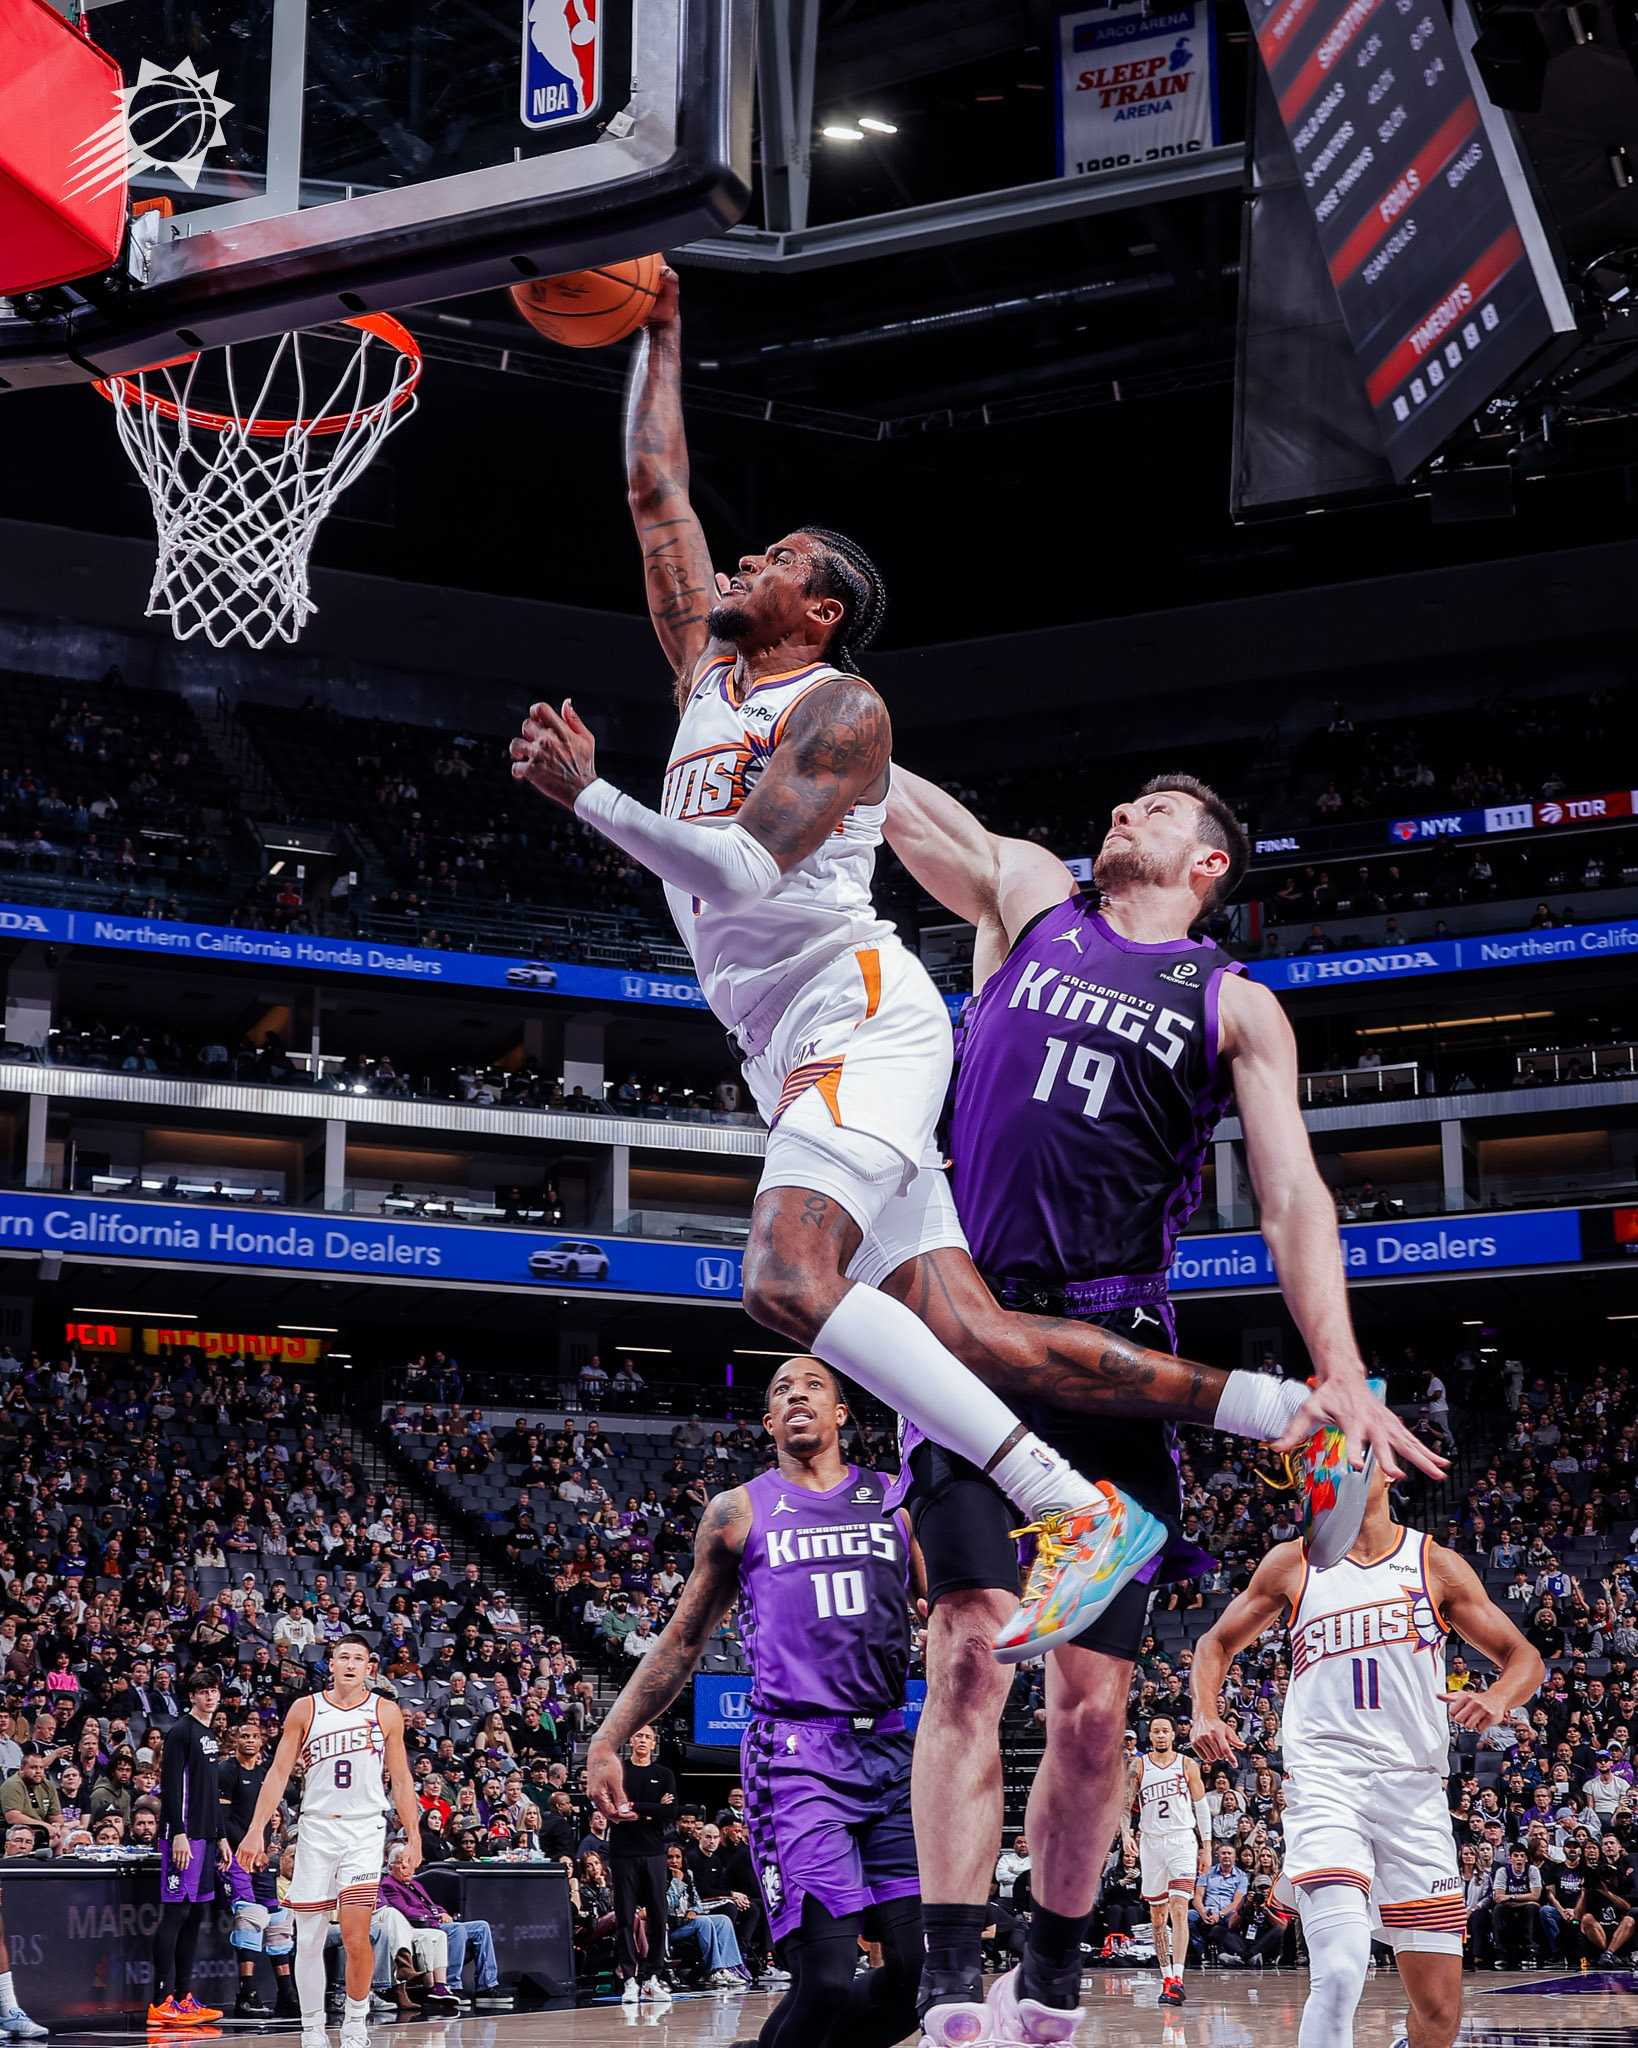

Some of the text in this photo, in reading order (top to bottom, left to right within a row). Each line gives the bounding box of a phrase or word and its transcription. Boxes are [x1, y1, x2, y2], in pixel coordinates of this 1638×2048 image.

[1096, 12, 1188, 41] ARCO ARENA
[1076, 56, 1166, 91] SLEEP
[532, 82, 571, 116] NBA
[1099, 73, 1191, 109] TRAIN
[1113, 100, 1173, 122] ARENA
[1409, 282, 1473, 355] TIMEOUTS
[660, 752, 738, 820] UNS
[1494, 810, 1526, 827] 111
[1565, 799, 1606, 818] TOR
[1421, 817, 1462, 836] NYK
[1255, 837, 1300, 853] FINAL
[94, 921, 191, 948] Northern
[196, 932, 292, 959] California
[296, 943, 363, 966] Honda
[368, 950, 442, 975] Dealers
[1315, 952, 1439, 978] HONDA
[1480, 932, 1576, 961] Northern
[1061, 974, 1155, 1012] SACRAMENTO
[1032, 1037, 1116, 1118] 19
[43, 1210, 200, 1248] California
[209, 1223, 315, 1257] Honda
[325, 1231, 442, 1266] Dealers
[1377, 1231, 1497, 1264] Dealers
[795, 1523, 868, 1536] SACRAMENTO
[1389, 1563, 1418, 1574] PayPal
[810, 1570, 868, 1619] 10
[1351, 1658, 1382, 1710] 11
[334, 1759, 352, 1789] 8
[1158, 1800, 1169, 1819] 2
[125, 1960, 154, 1985] NB
